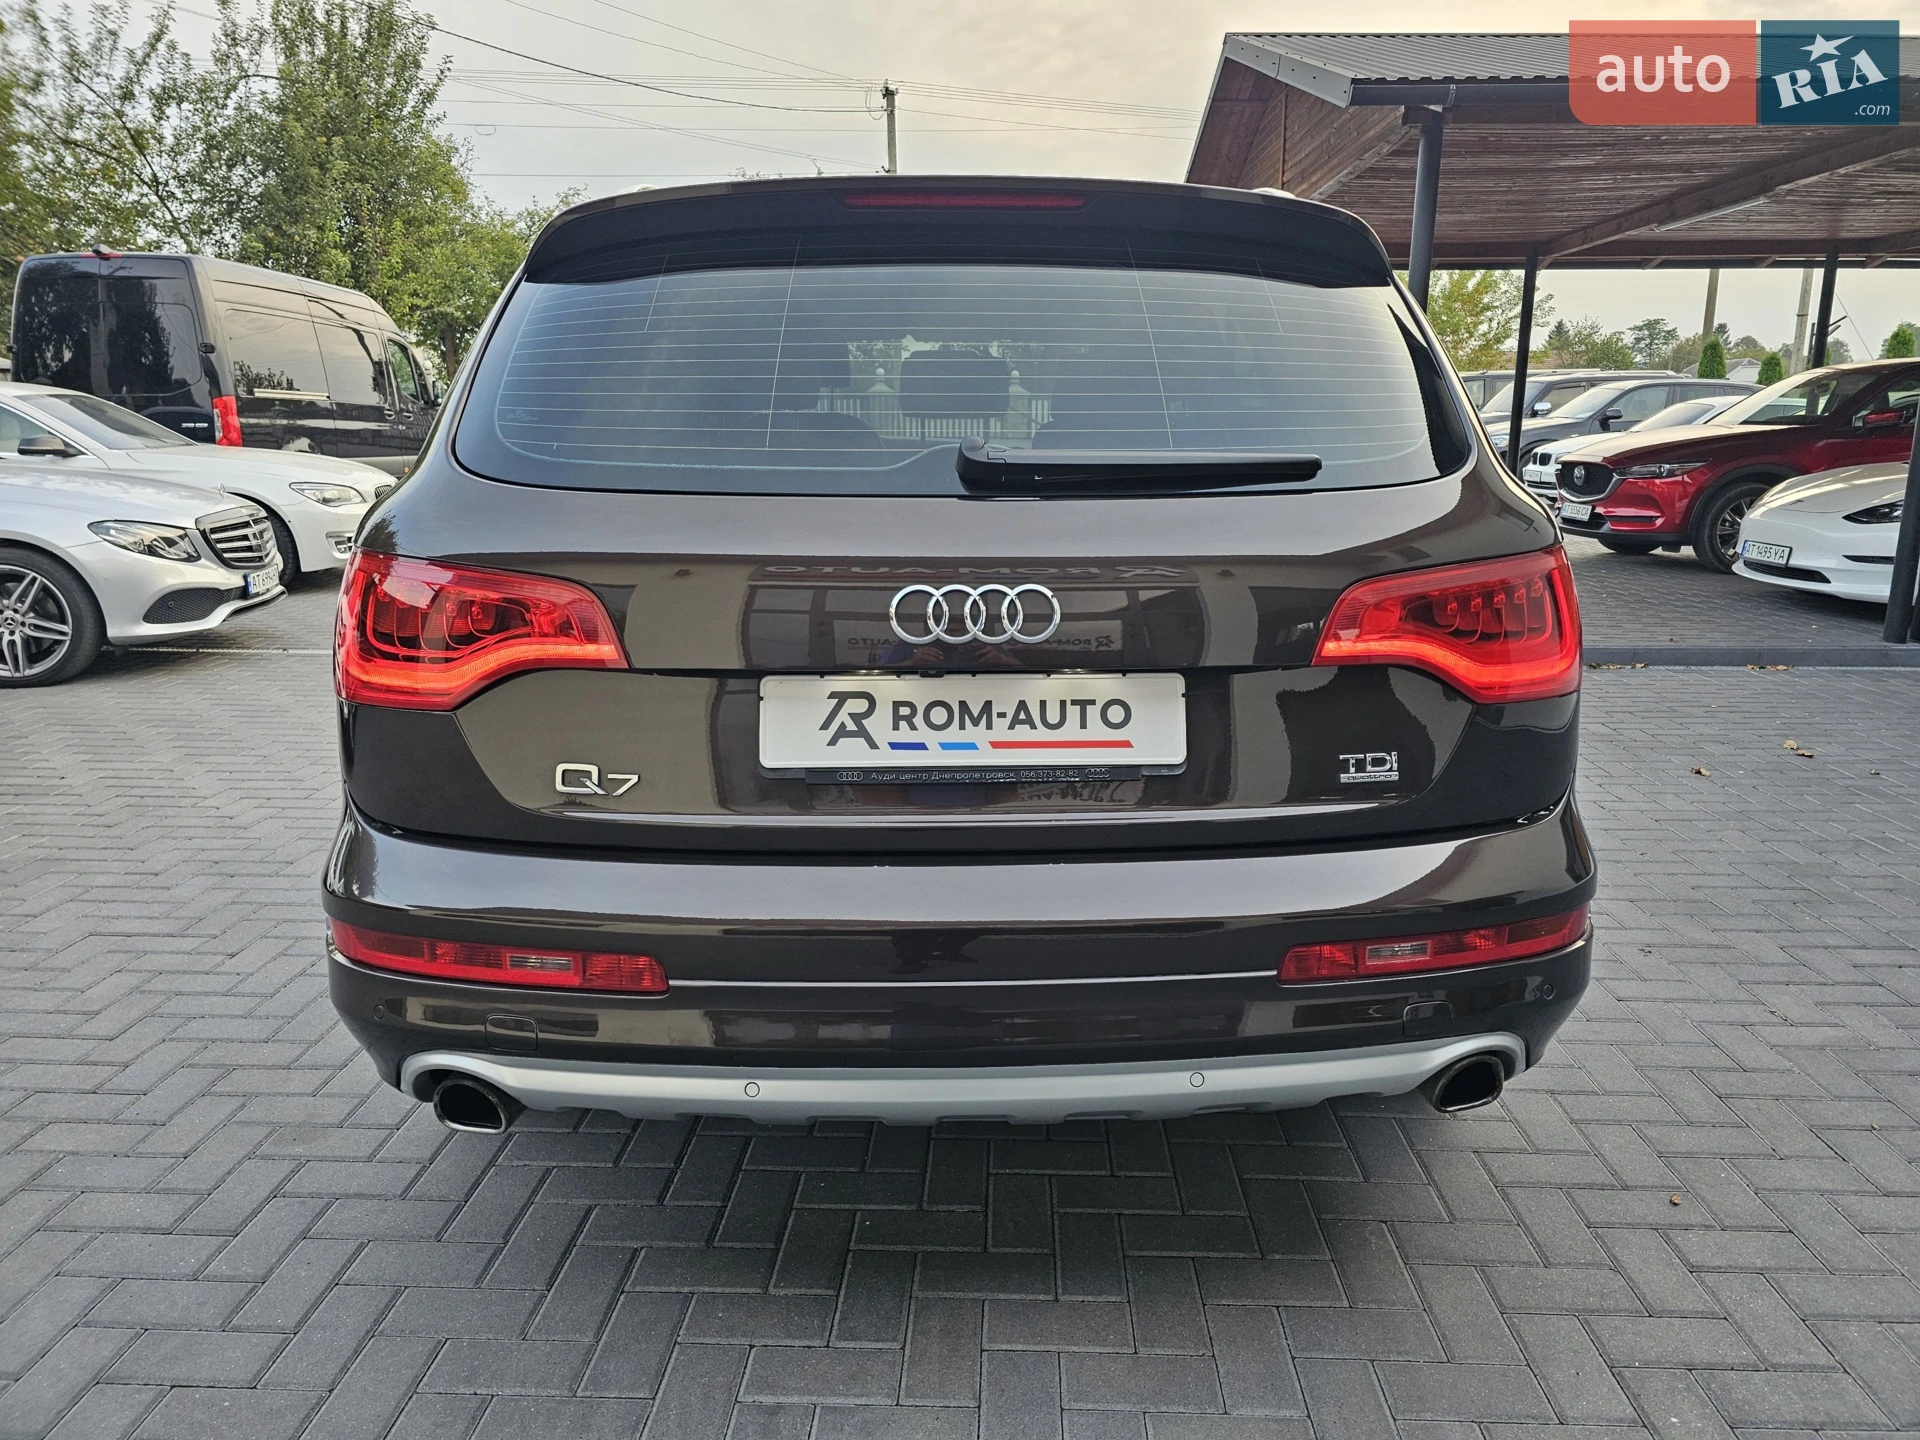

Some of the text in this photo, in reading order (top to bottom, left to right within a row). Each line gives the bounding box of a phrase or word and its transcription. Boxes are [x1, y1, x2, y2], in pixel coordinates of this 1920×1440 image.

[1746, 543, 1785, 562] AT 1495 YA
[253, 574, 260, 589] AT
[891, 698, 1132, 732] ROM-AUTO
[1339, 752, 1397, 773] TDI
[555, 763, 640, 796] Q7
[931, 771, 1016, 781] Днепропетровск
